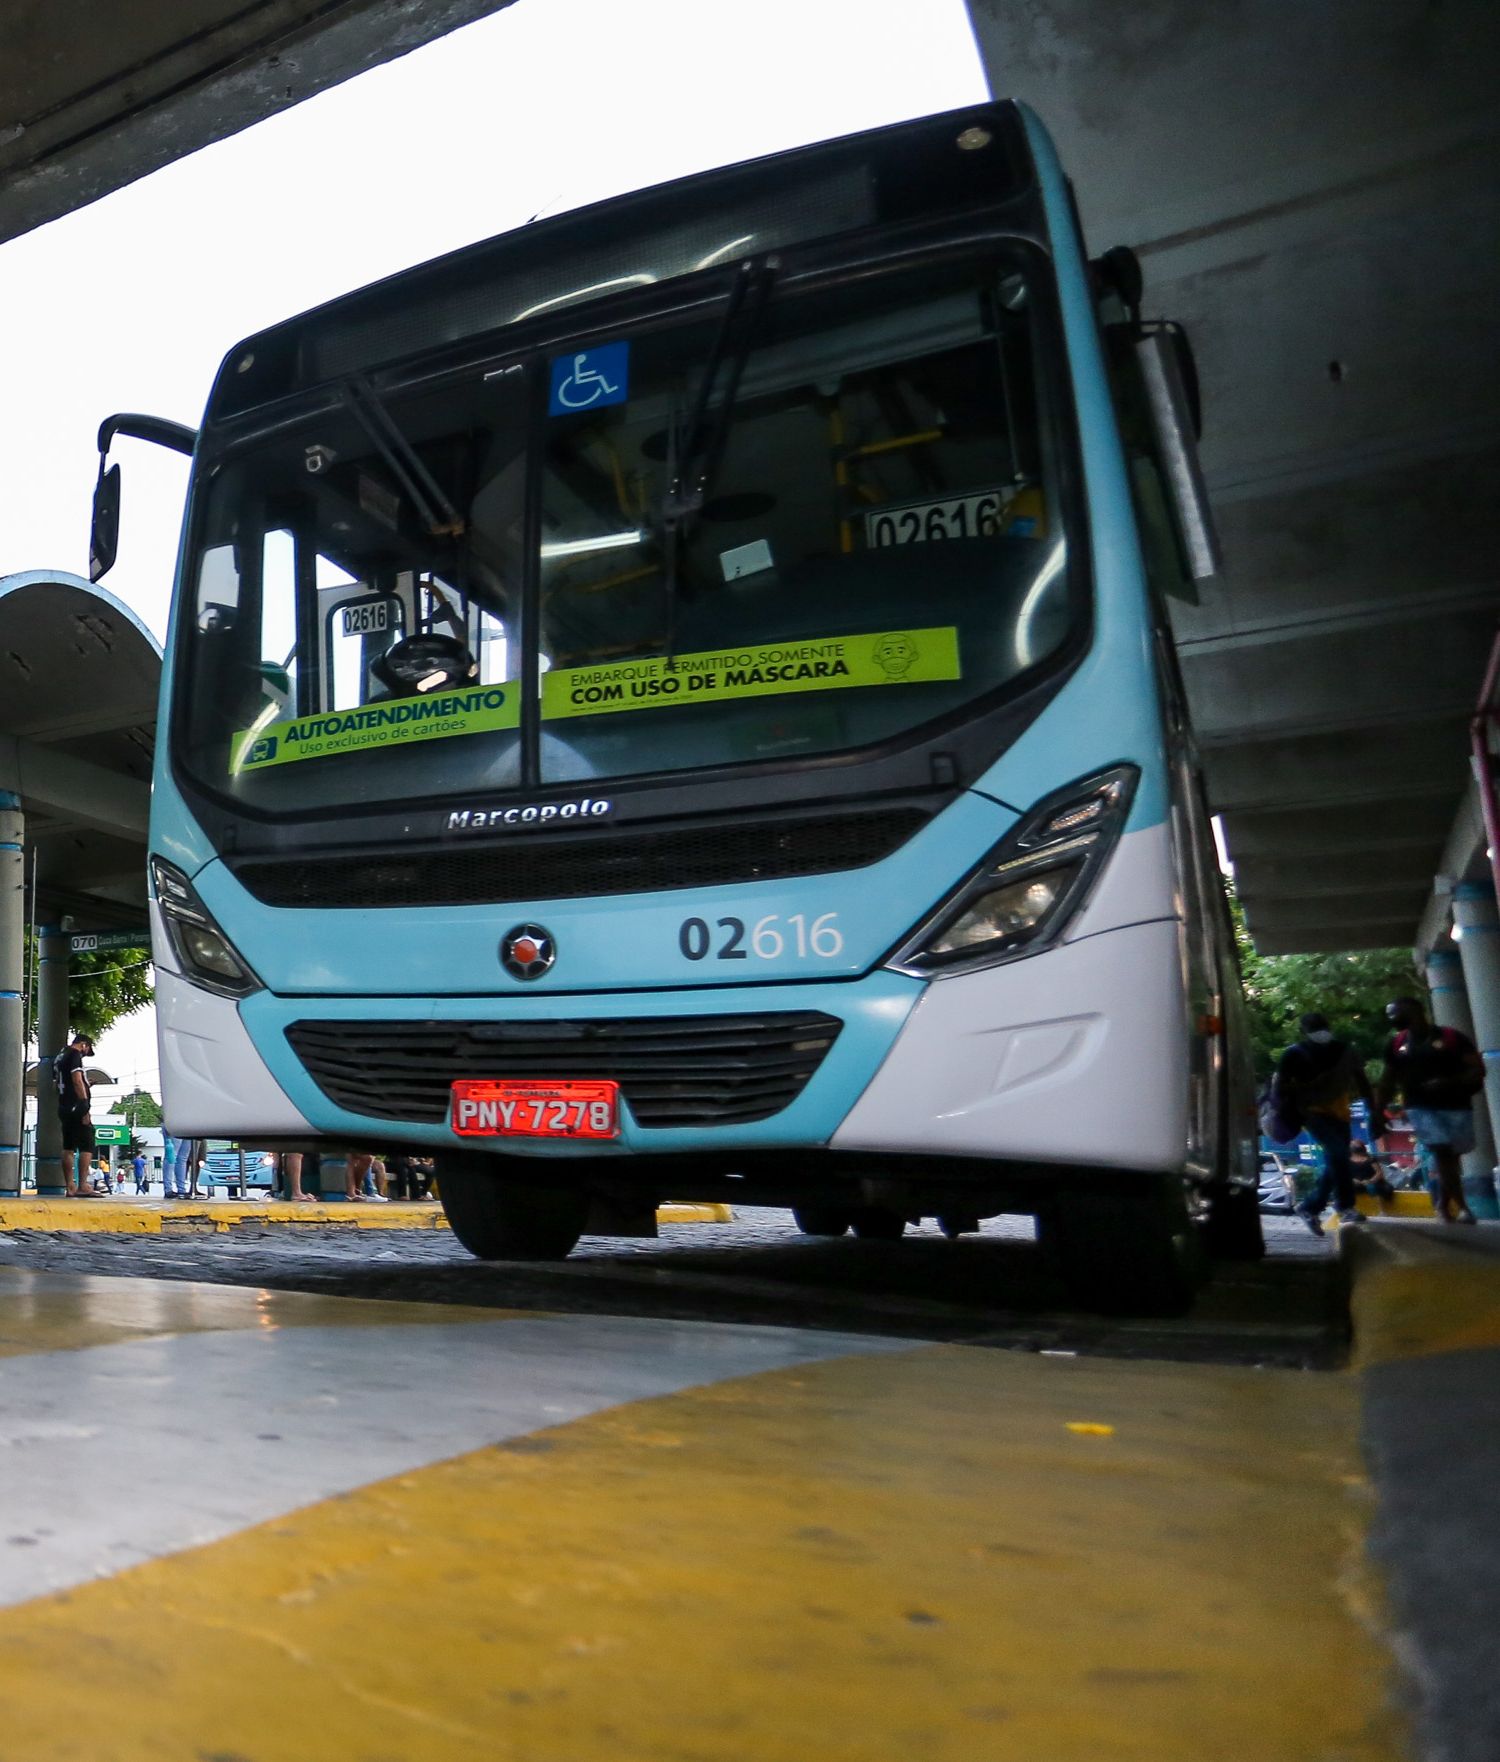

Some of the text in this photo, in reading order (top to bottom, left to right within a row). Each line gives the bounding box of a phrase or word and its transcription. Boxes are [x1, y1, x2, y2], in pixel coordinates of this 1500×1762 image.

[875, 498, 997, 547] 02616
[344, 605, 386, 633] 02616
[571, 665, 658, 686] EMBARQUE
[758, 644, 845, 665] SOMENTE
[571, 686, 623, 705] COM
[631, 677, 680, 698] USO
[688, 672, 717, 690] DE
[724, 660, 849, 687] MÁSCARA
[284, 689, 506, 744] AUTOATENDIMENTO
[300, 719, 467, 754] Uso exclusivo de cartões
[447, 799, 611, 829] Marcopolo
[72, 937, 96, 949] 070
[679, 912, 843, 961] 02616
